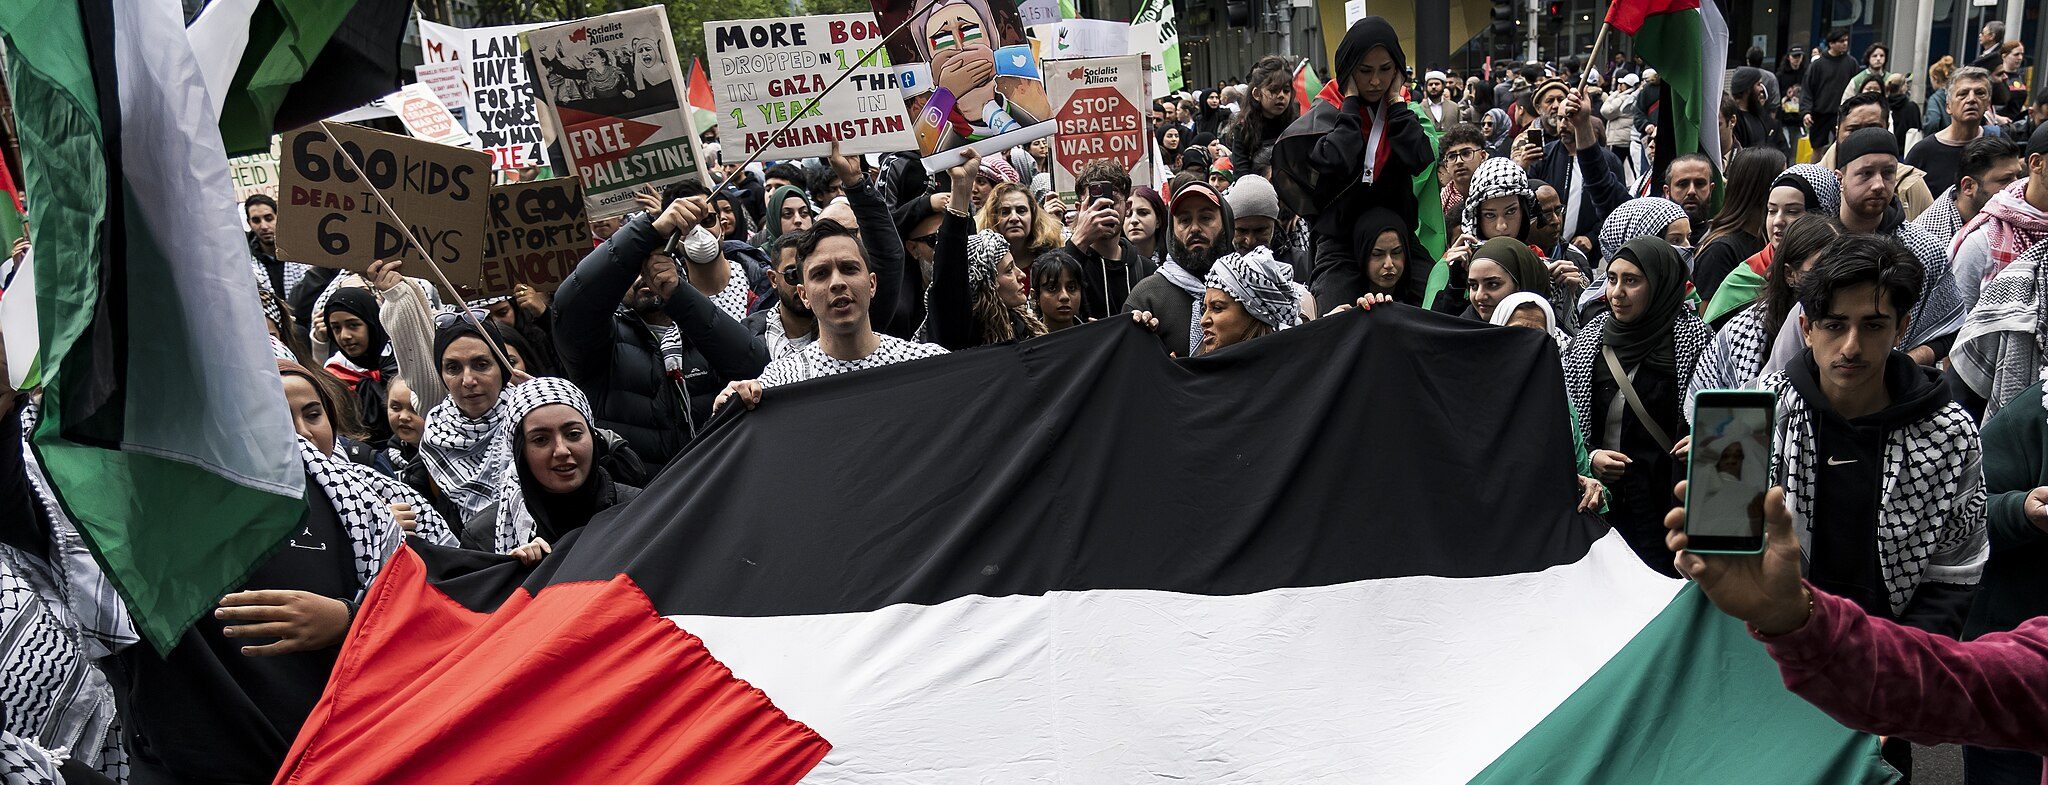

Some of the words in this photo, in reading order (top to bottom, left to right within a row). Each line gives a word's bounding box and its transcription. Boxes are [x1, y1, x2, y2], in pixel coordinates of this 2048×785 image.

[587, 22, 623, 38] Socialist
[590, 31, 624, 46] Alliance
[716, 22, 807, 53] MORE
[472, 36, 522, 60] LAN
[474, 58, 517, 87] HAVE
[721, 50, 817, 76] DROPPED
[819, 53, 832, 65] IN
[834, 49, 850, 71] 1
[1084, 66, 1118, 77] Socialist
[727, 82, 758, 102] IN
[768, 73, 827, 97] GAZA
[1084, 75, 1118, 85] Alliance
[404, 99, 429, 112] STOP
[474, 88, 511, 113] FOR
[511, 82, 534, 106] IS
[1072, 96, 1120, 115] STOP
[410, 117, 433, 129] WAR
[432, 113, 448, 124] ON
[730, 107, 747, 129] 1
[757, 97, 824, 125] YEAR
[858, 94, 887, 112] IN
[745, 115, 905, 153] AFGHANISTAN
[1060, 115, 1137, 135] ISRAEL'S
[476, 128, 508, 148] YOU
[569, 122, 631, 160] FREE
[1060, 137, 1104, 156] WAR
[1109, 134, 1137, 152] ON
[293, 131, 398, 190] 600
[403, 155, 474, 200] KIDS
[483, 145, 523, 169] DIE
[580, 143, 694, 189] PALESTINE
[291, 185, 356, 211] DEAD
[361, 192, 394, 215] IN
[317, 213, 350, 255] 6
[374, 222, 463, 263] DAYS
